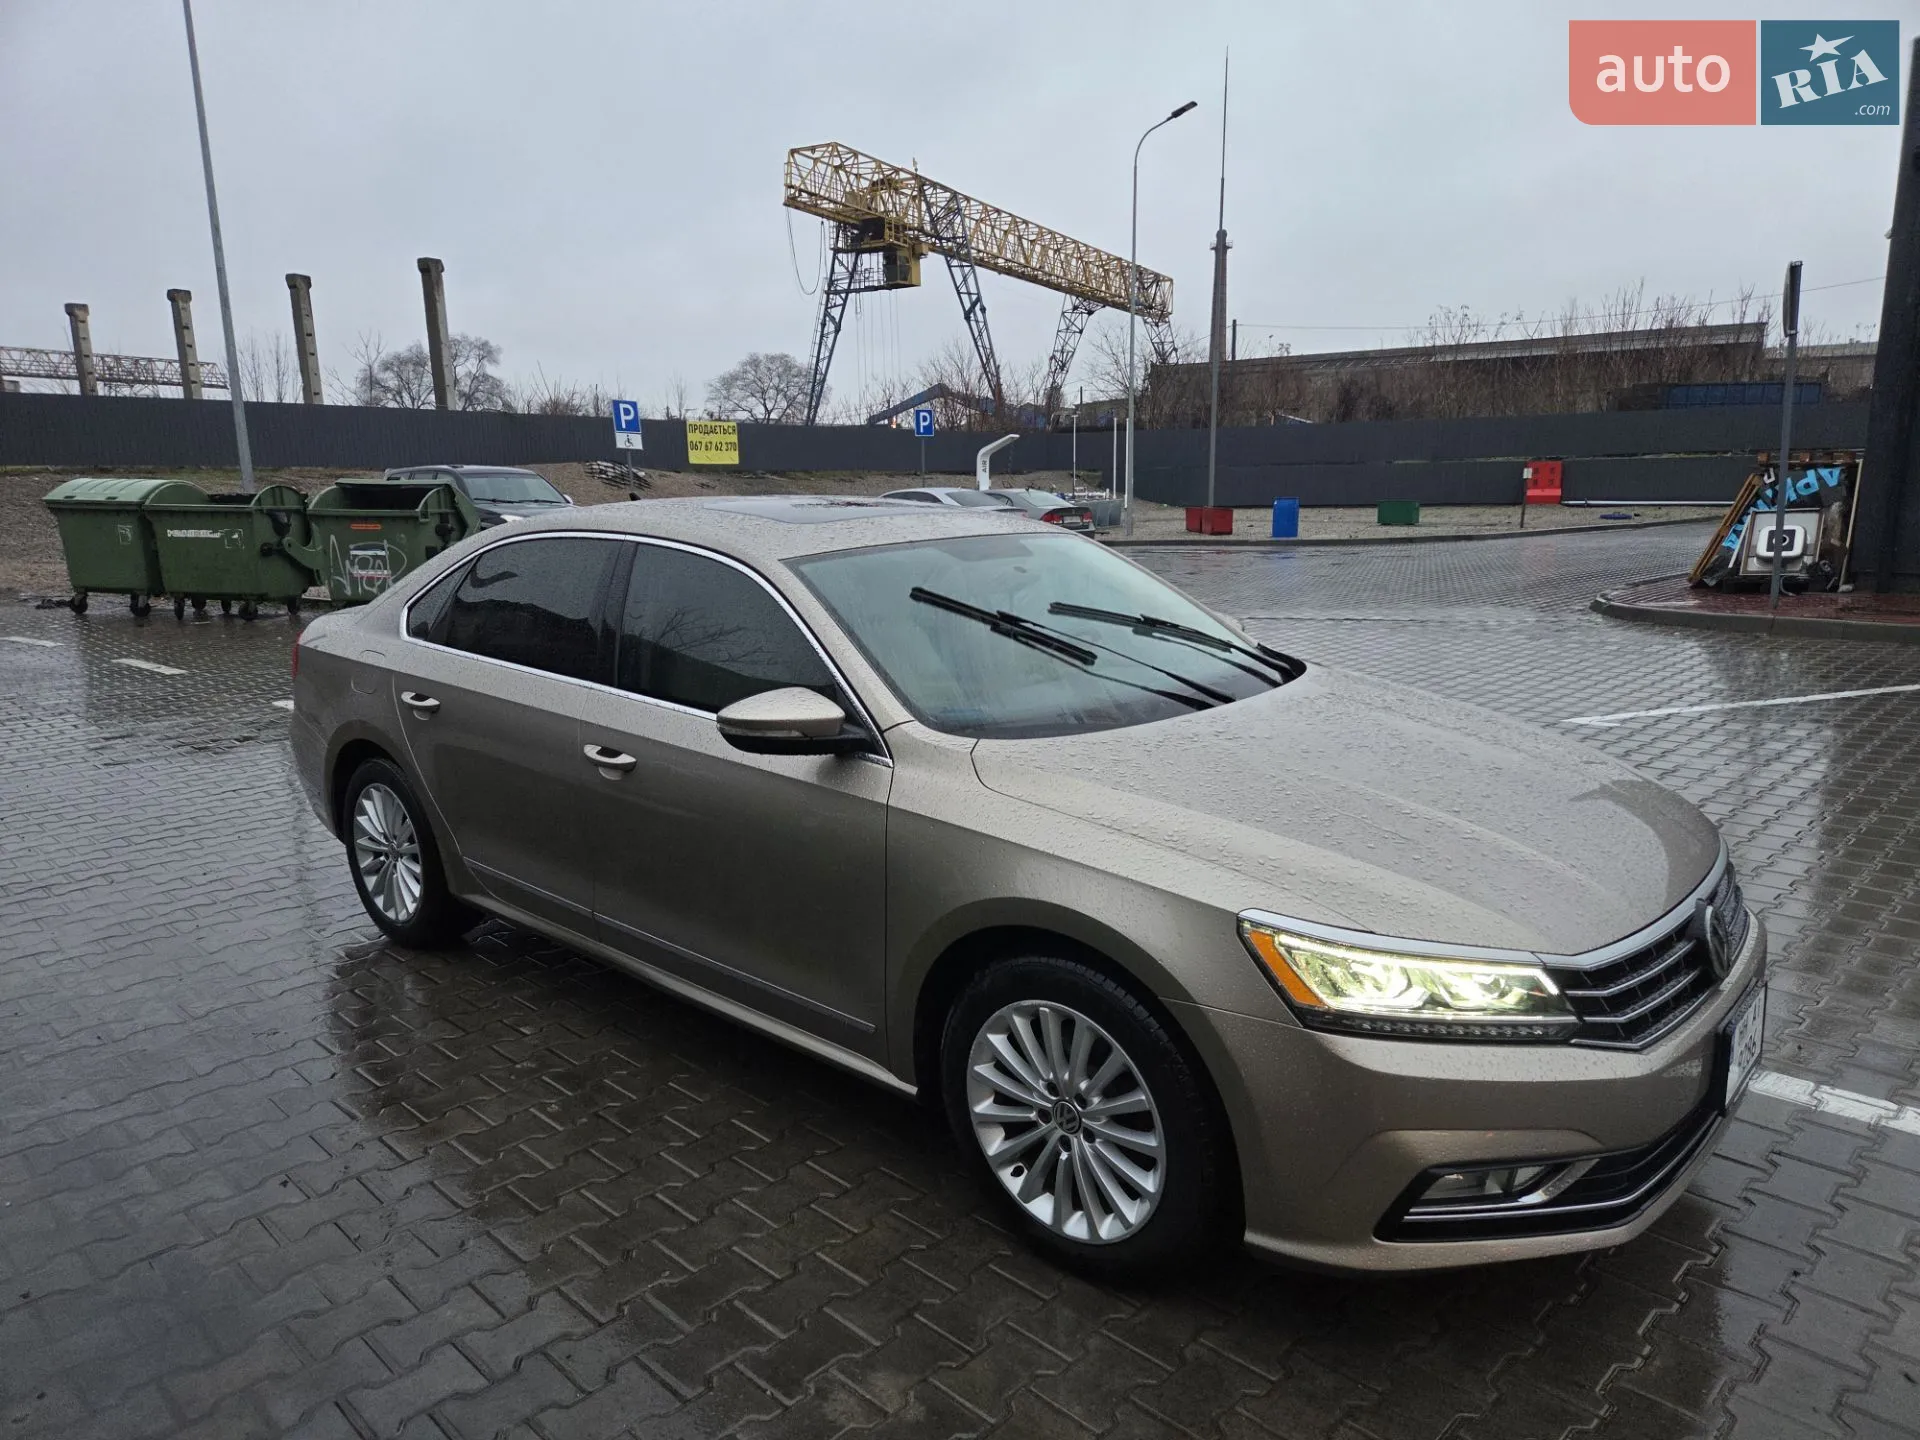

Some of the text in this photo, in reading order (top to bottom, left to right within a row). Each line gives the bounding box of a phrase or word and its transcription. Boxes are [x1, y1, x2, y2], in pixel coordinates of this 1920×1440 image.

[619, 403, 635, 429] P
[919, 411, 930, 433] P
[688, 423, 737, 436] ПРОДАЄТЬСЯ
[689, 440, 703, 451] 067
[714, 441, 723, 452] 62
[724, 441, 737, 452] 370
